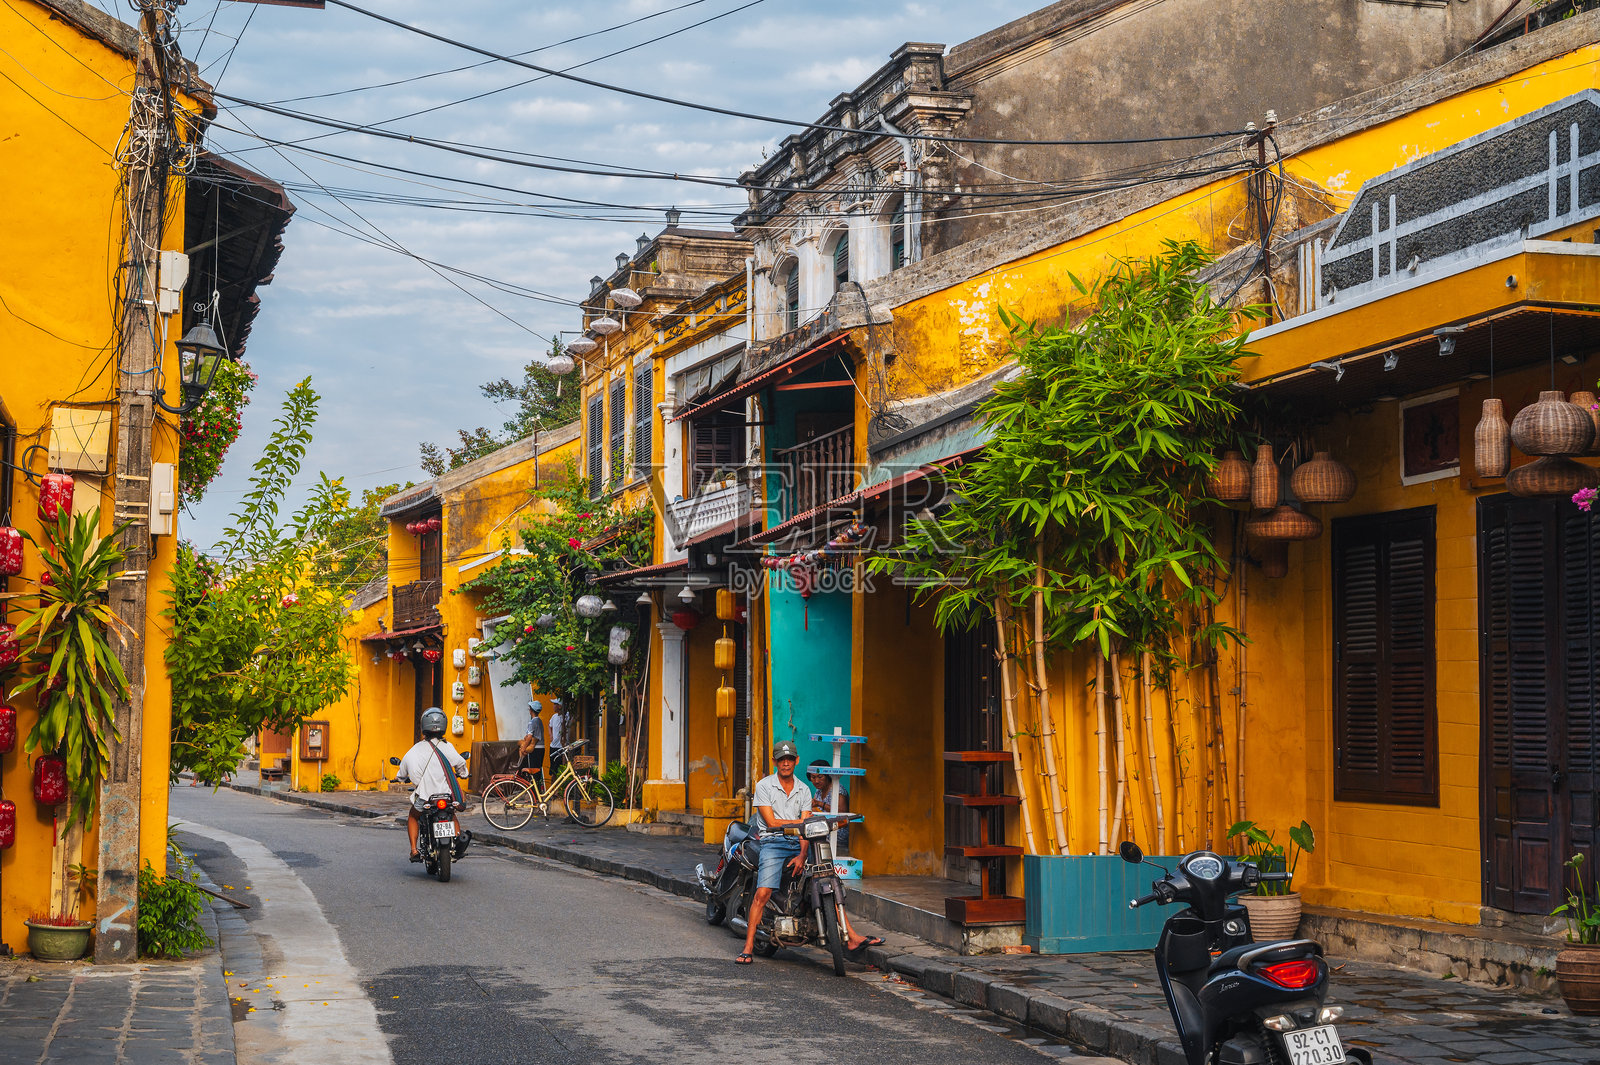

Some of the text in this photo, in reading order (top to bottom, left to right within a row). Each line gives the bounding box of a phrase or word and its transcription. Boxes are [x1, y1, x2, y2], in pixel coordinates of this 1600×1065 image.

[834, 866, 848, 875] Vie
[1293, 1028, 1330, 1049] 92-C1
[1293, 1044, 1342, 1065] 220.30
